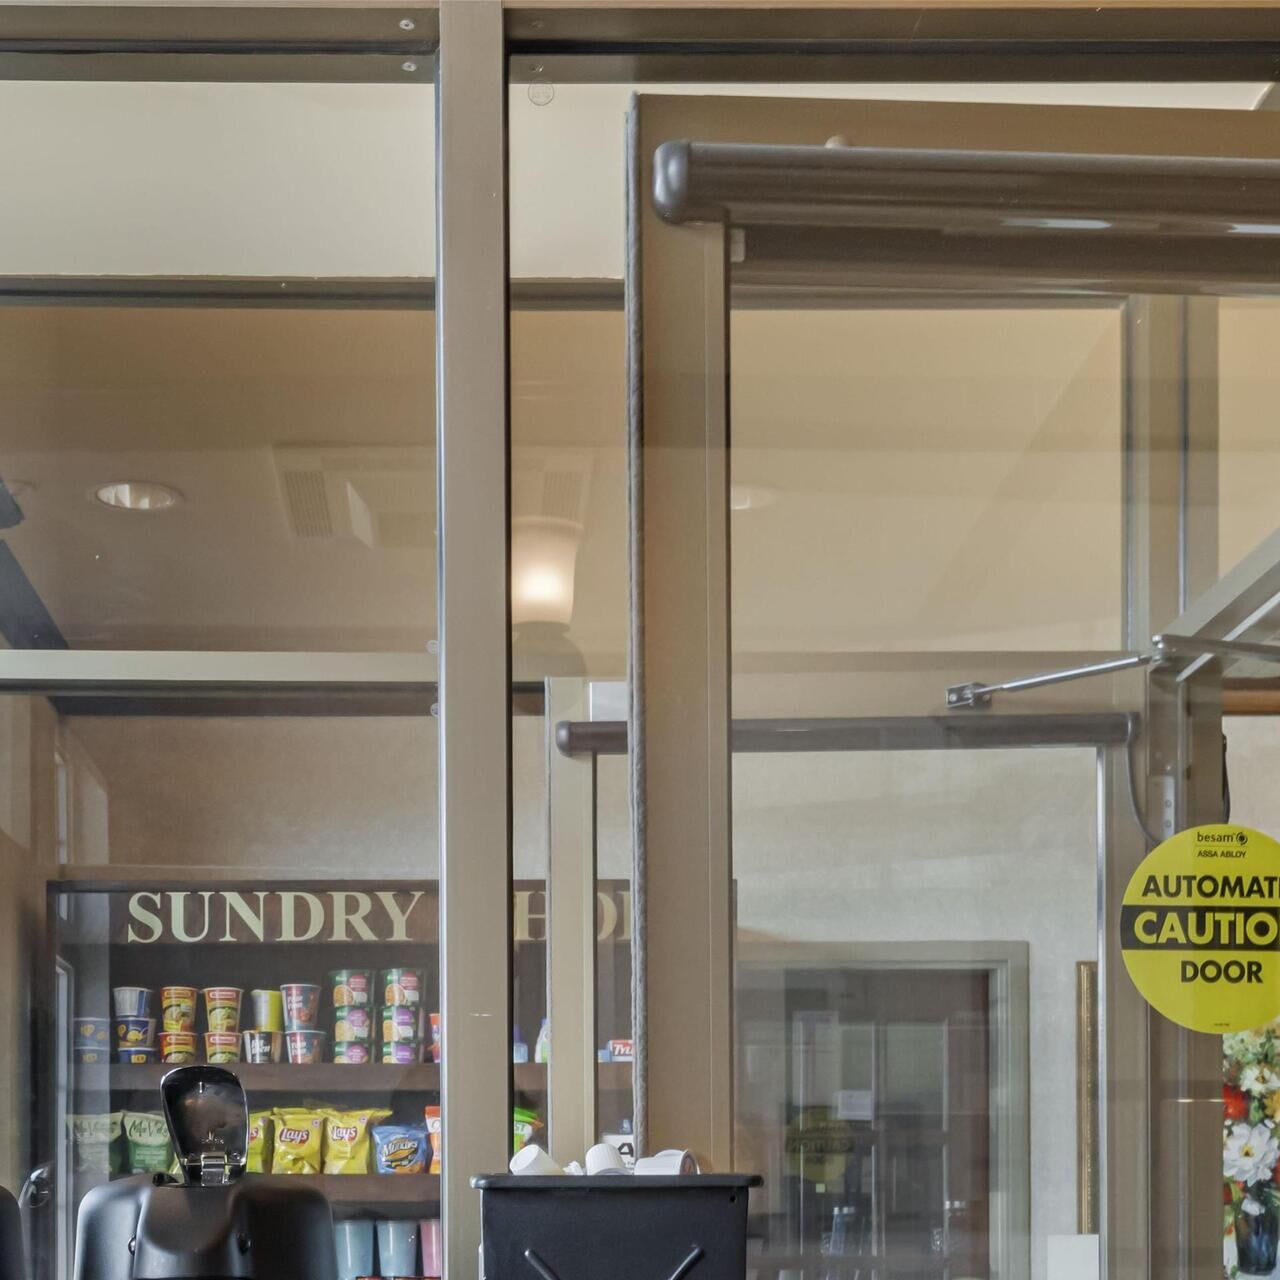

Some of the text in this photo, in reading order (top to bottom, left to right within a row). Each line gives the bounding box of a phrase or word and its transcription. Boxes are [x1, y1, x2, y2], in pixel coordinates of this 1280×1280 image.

[1197, 831, 1234, 843] besam
[1197, 850, 1247, 858] ASSA ABLOY
[127, 891, 424, 943] SUNDRY
[1180, 959, 1263, 984] DOOR
